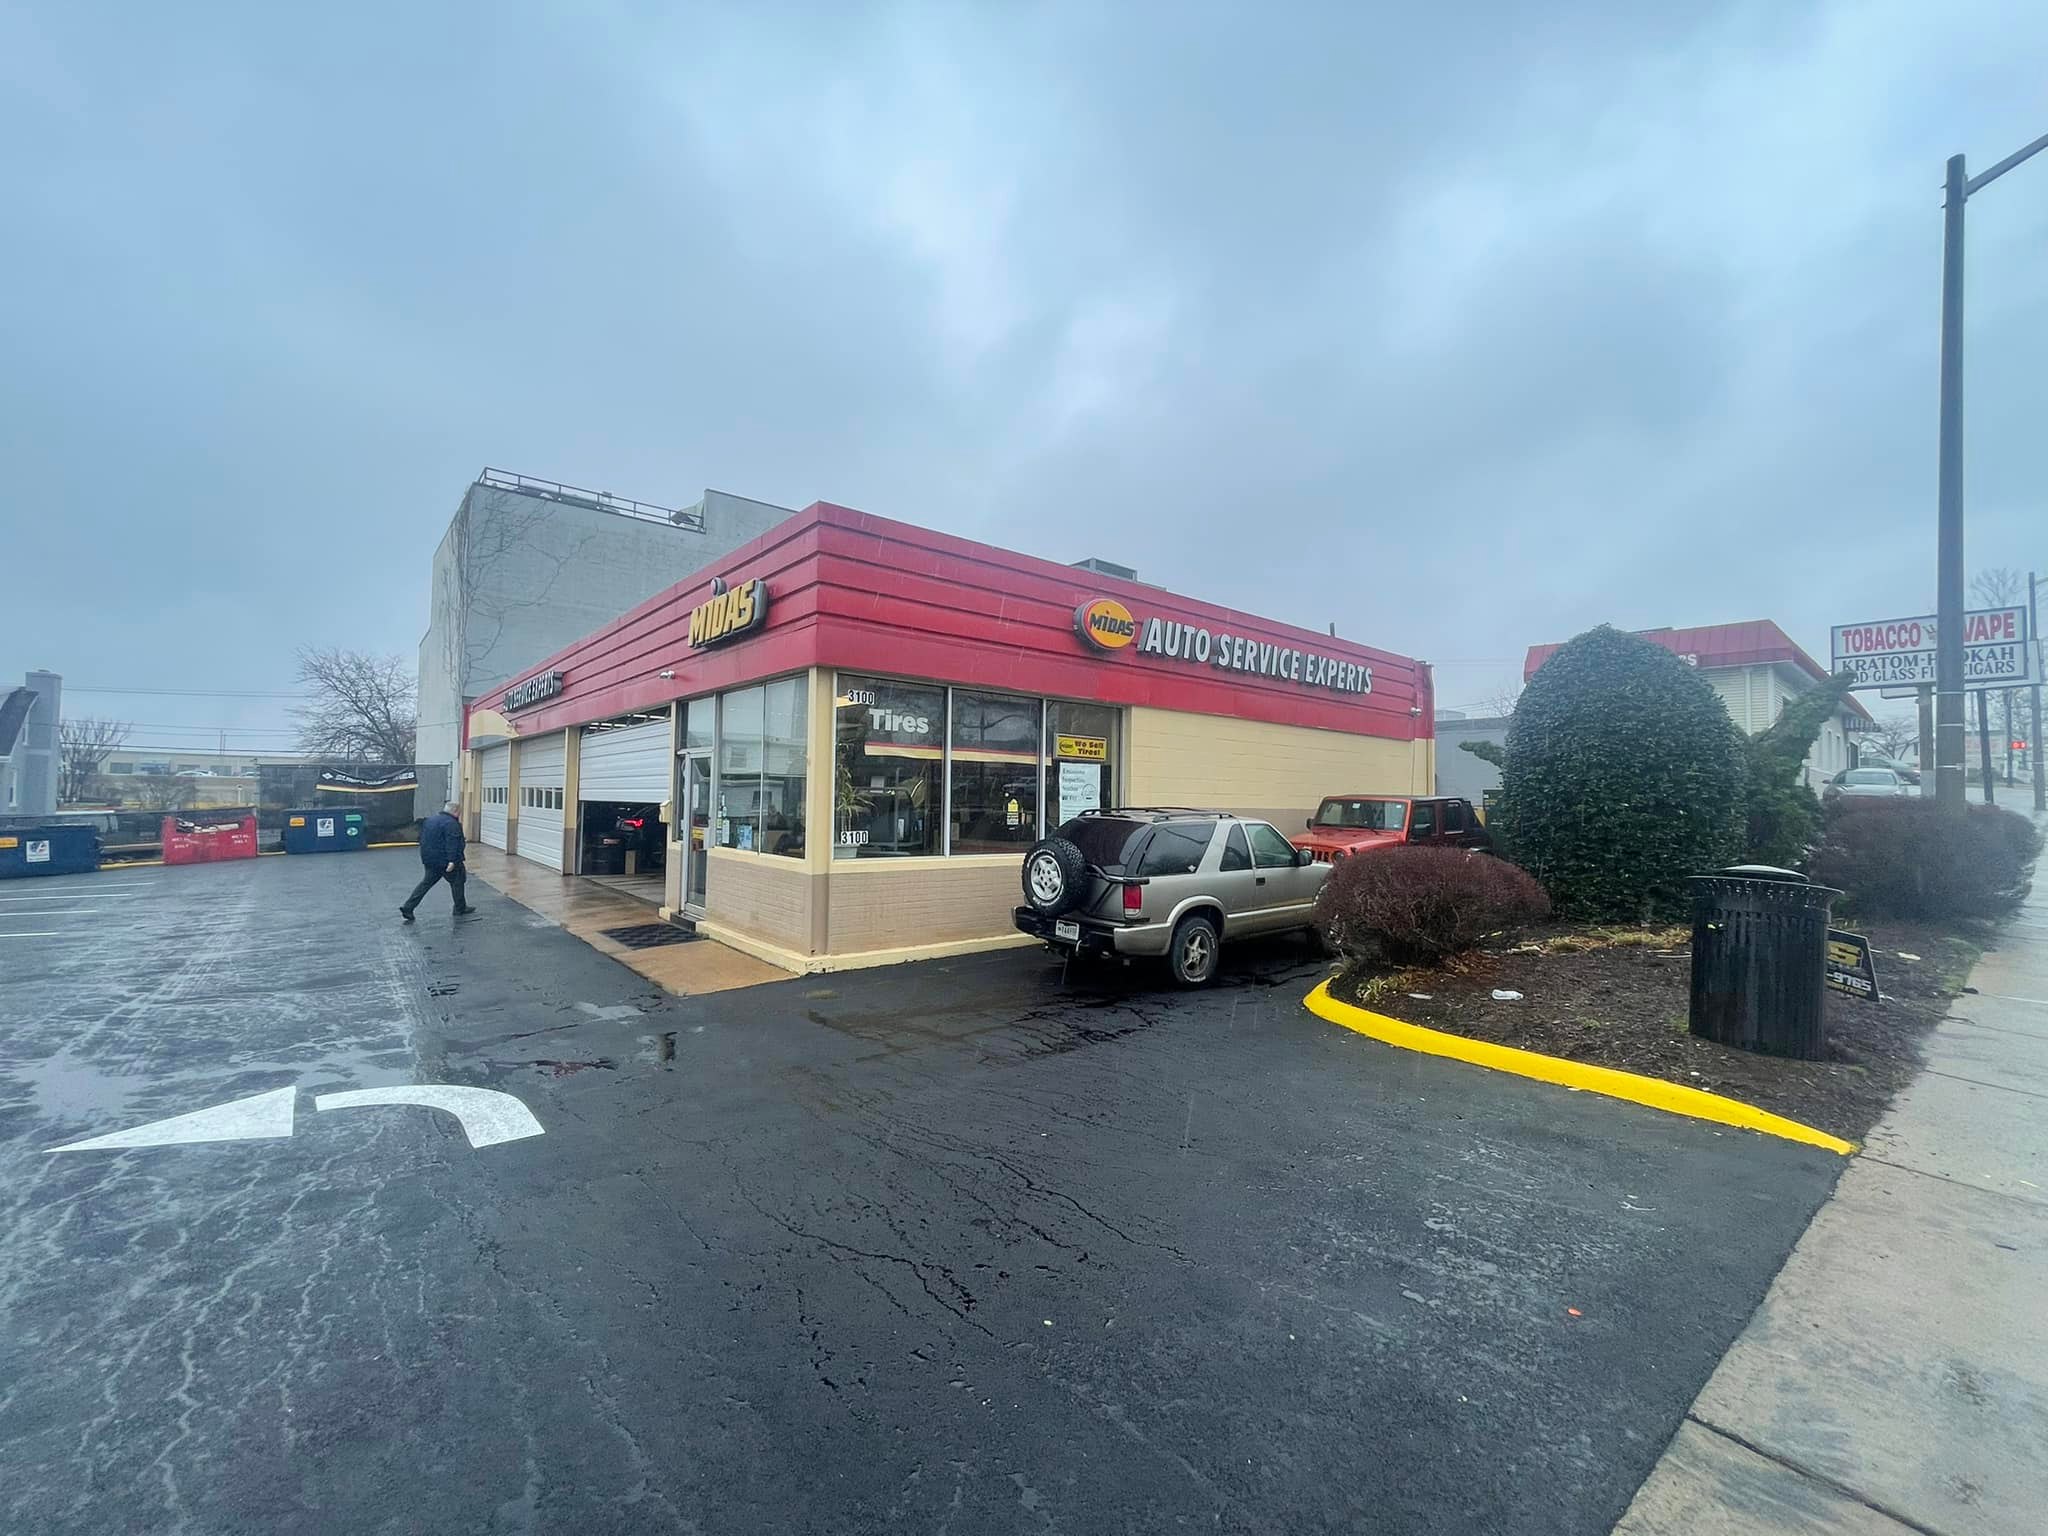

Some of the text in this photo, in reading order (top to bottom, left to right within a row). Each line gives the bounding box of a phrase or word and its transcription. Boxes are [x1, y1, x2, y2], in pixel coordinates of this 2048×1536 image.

[1089, 609, 1135, 638] MIDAS
[1841, 622, 1921, 654] TOBACCO
[1145, 617, 1373, 694] AUTO SERVICE EXPERTS
[848, 689, 875, 705] 3100
[869, 708, 930, 734] Tires
[841, 831, 868, 845] 3100
